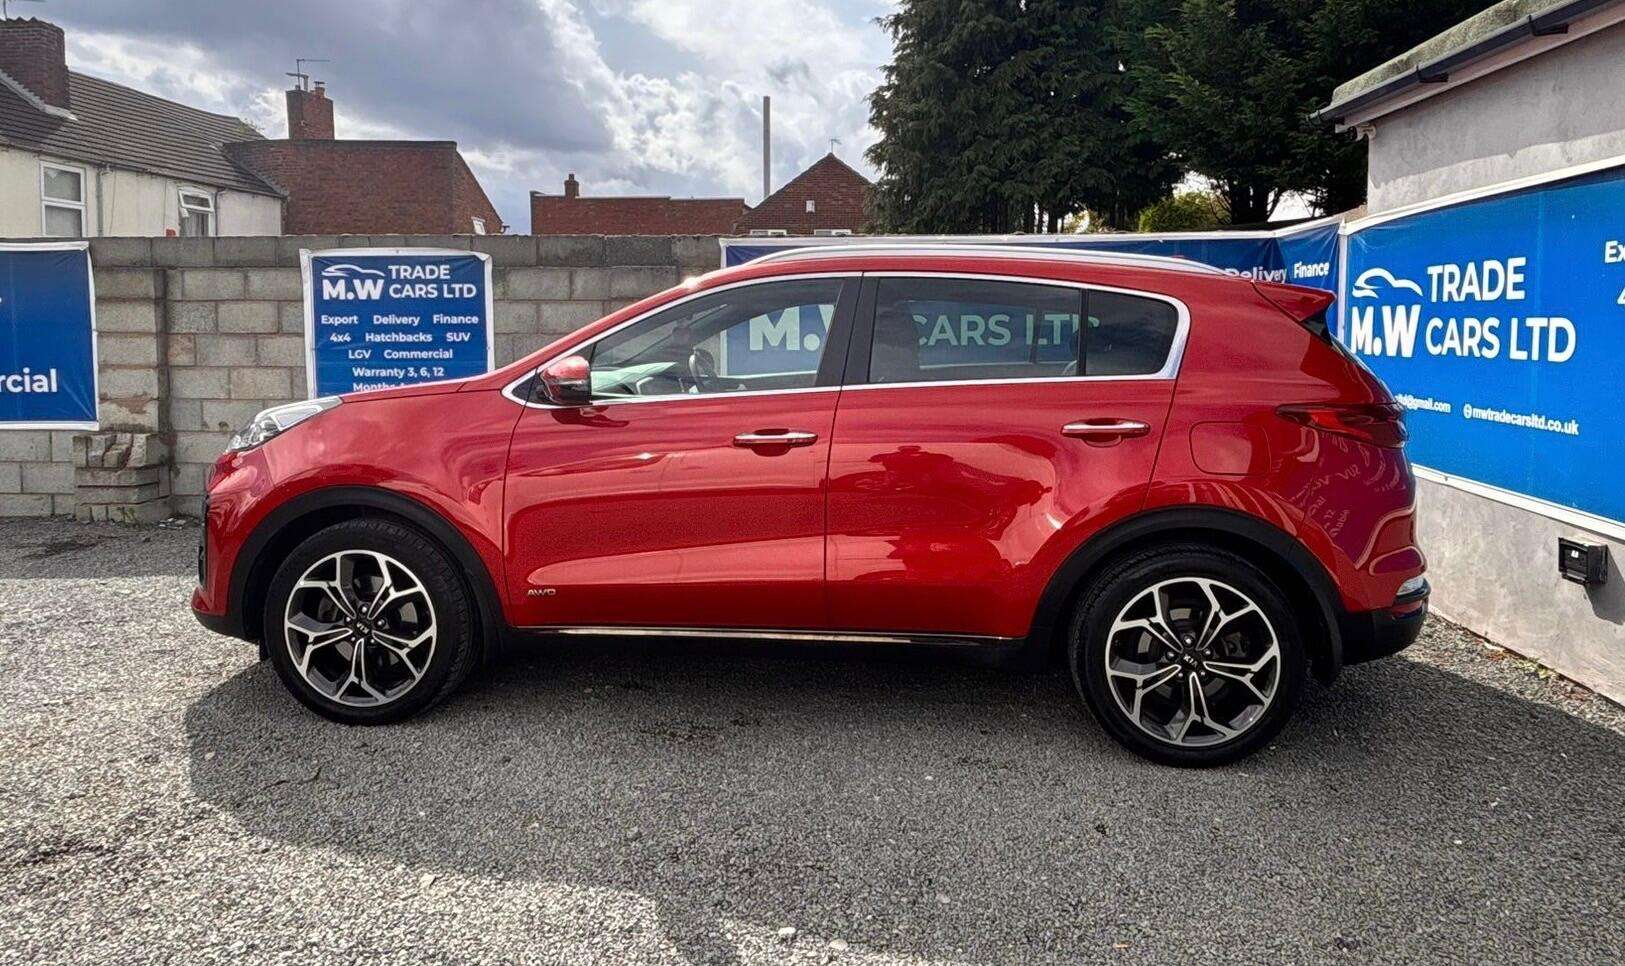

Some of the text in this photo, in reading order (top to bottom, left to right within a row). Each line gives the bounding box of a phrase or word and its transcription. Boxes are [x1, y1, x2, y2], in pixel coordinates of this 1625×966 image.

[387, 265, 451, 280] TRADE
[1293, 261, 1330, 279] Finance
[1427, 256, 1527, 303] TRADE
[322, 279, 385, 300] M.W
[388, 284, 477, 298] CARS LTD
[321, 314, 479, 326] Export Delivery Finance
[329, 332, 471, 342] 4x4 Hatchbacks SUV
[1350, 304, 1421, 358] M.W
[1425, 317, 1576, 363] CARS LTD
[348, 349, 453, 359] LGV Commercial
[352, 367, 445, 379] Warranty 3, 6, 12
[1472, 404, 1580, 436] mwtradecarsltd.co.uk
[528, 588, 557, 597] AWD
[1183, 653, 1198, 668] KIA
